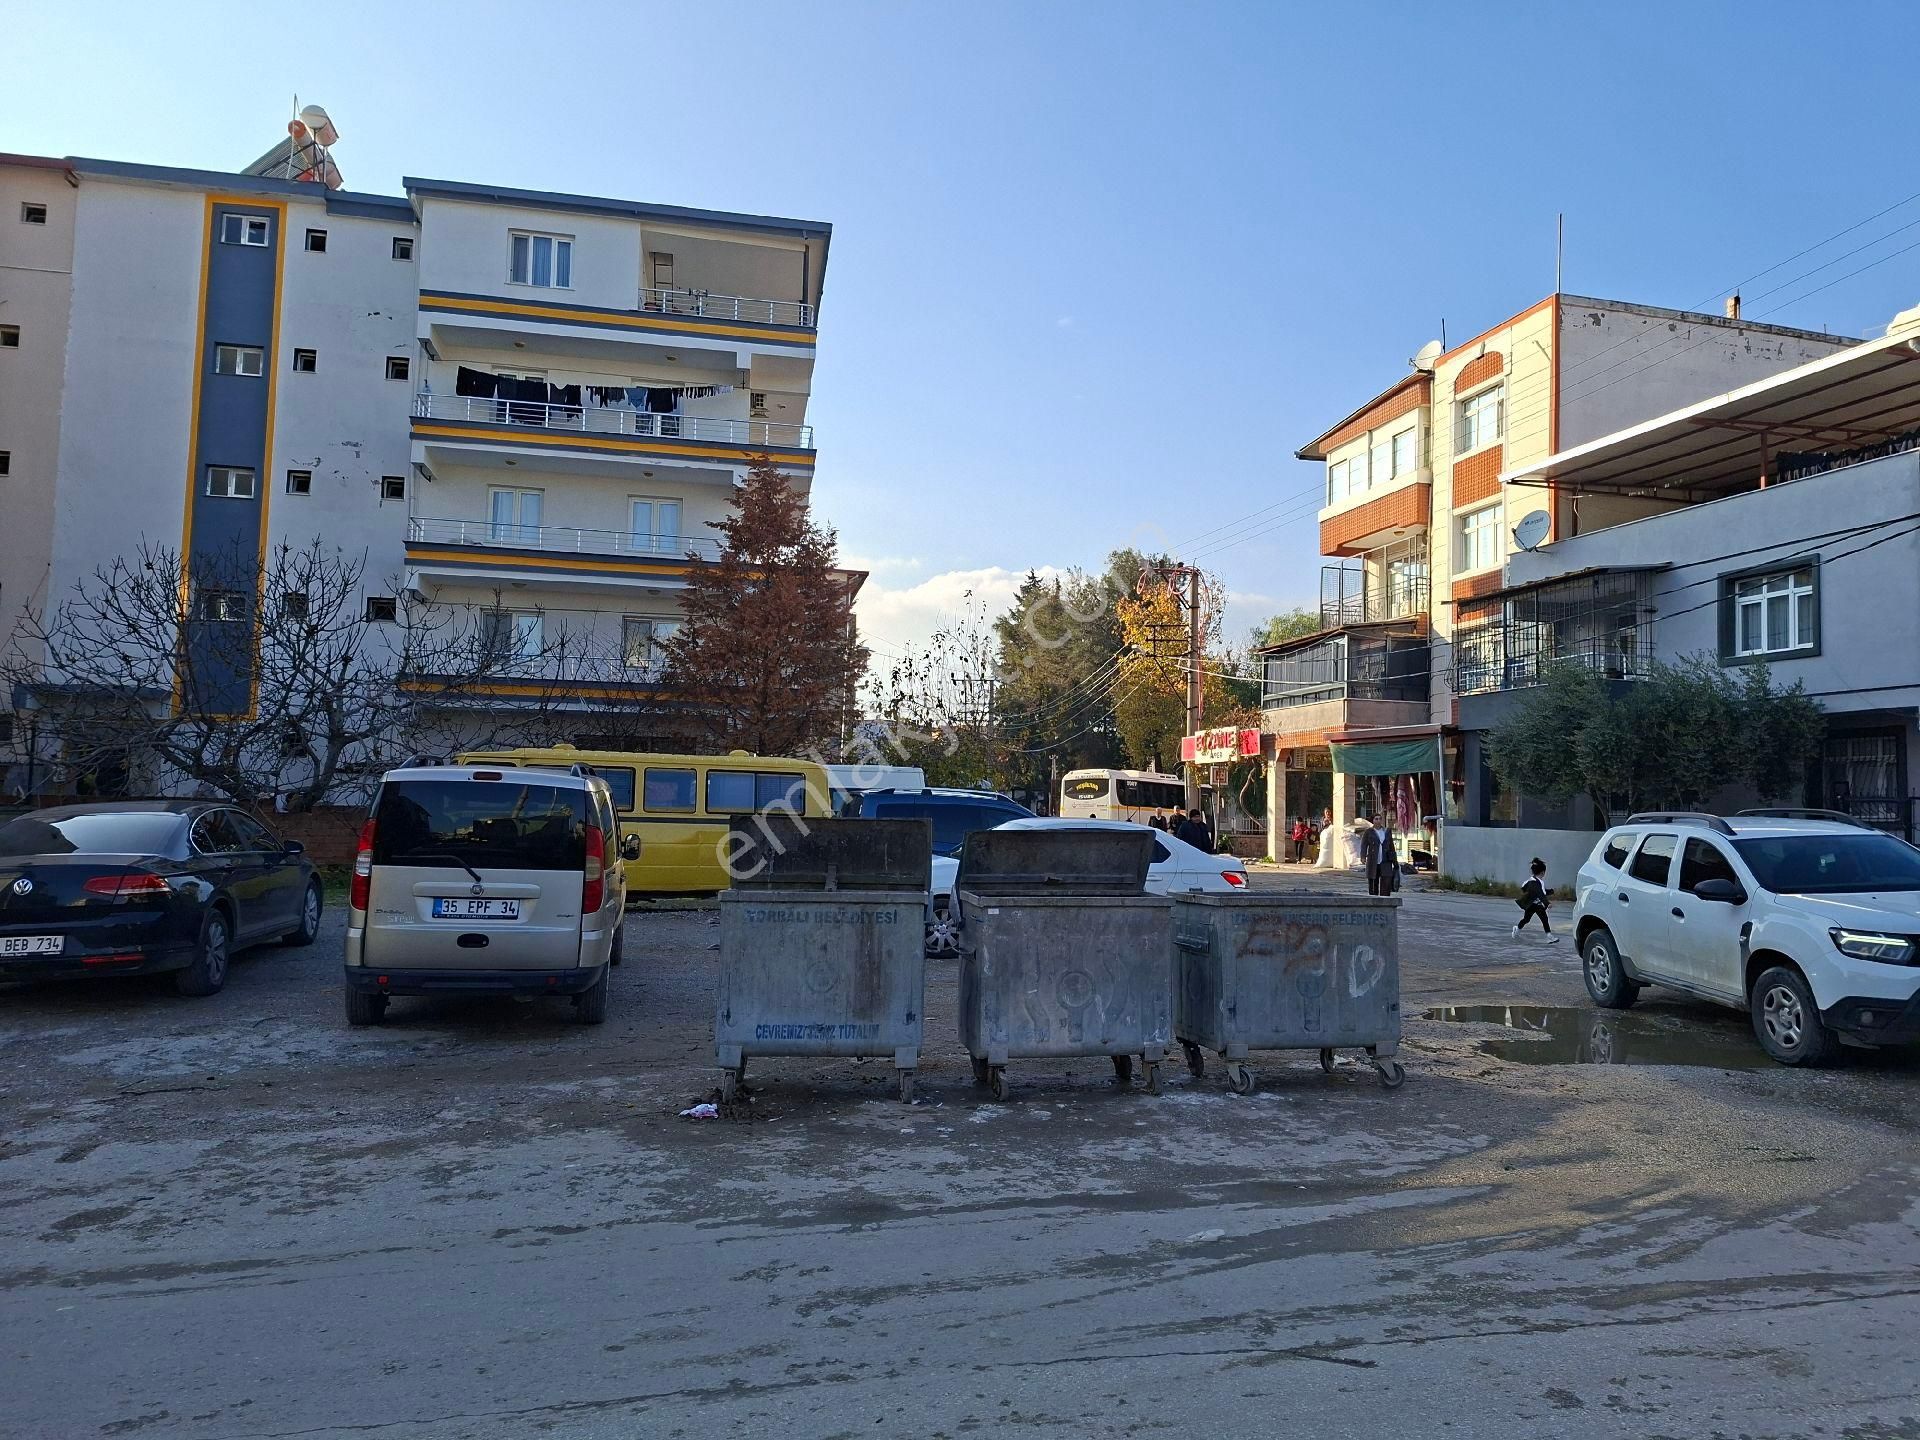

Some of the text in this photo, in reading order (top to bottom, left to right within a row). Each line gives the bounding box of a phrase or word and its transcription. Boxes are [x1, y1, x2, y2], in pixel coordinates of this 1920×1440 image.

[442, 900, 516, 914] 35 EPF 34
[4, 938, 60, 951] BEB 734
